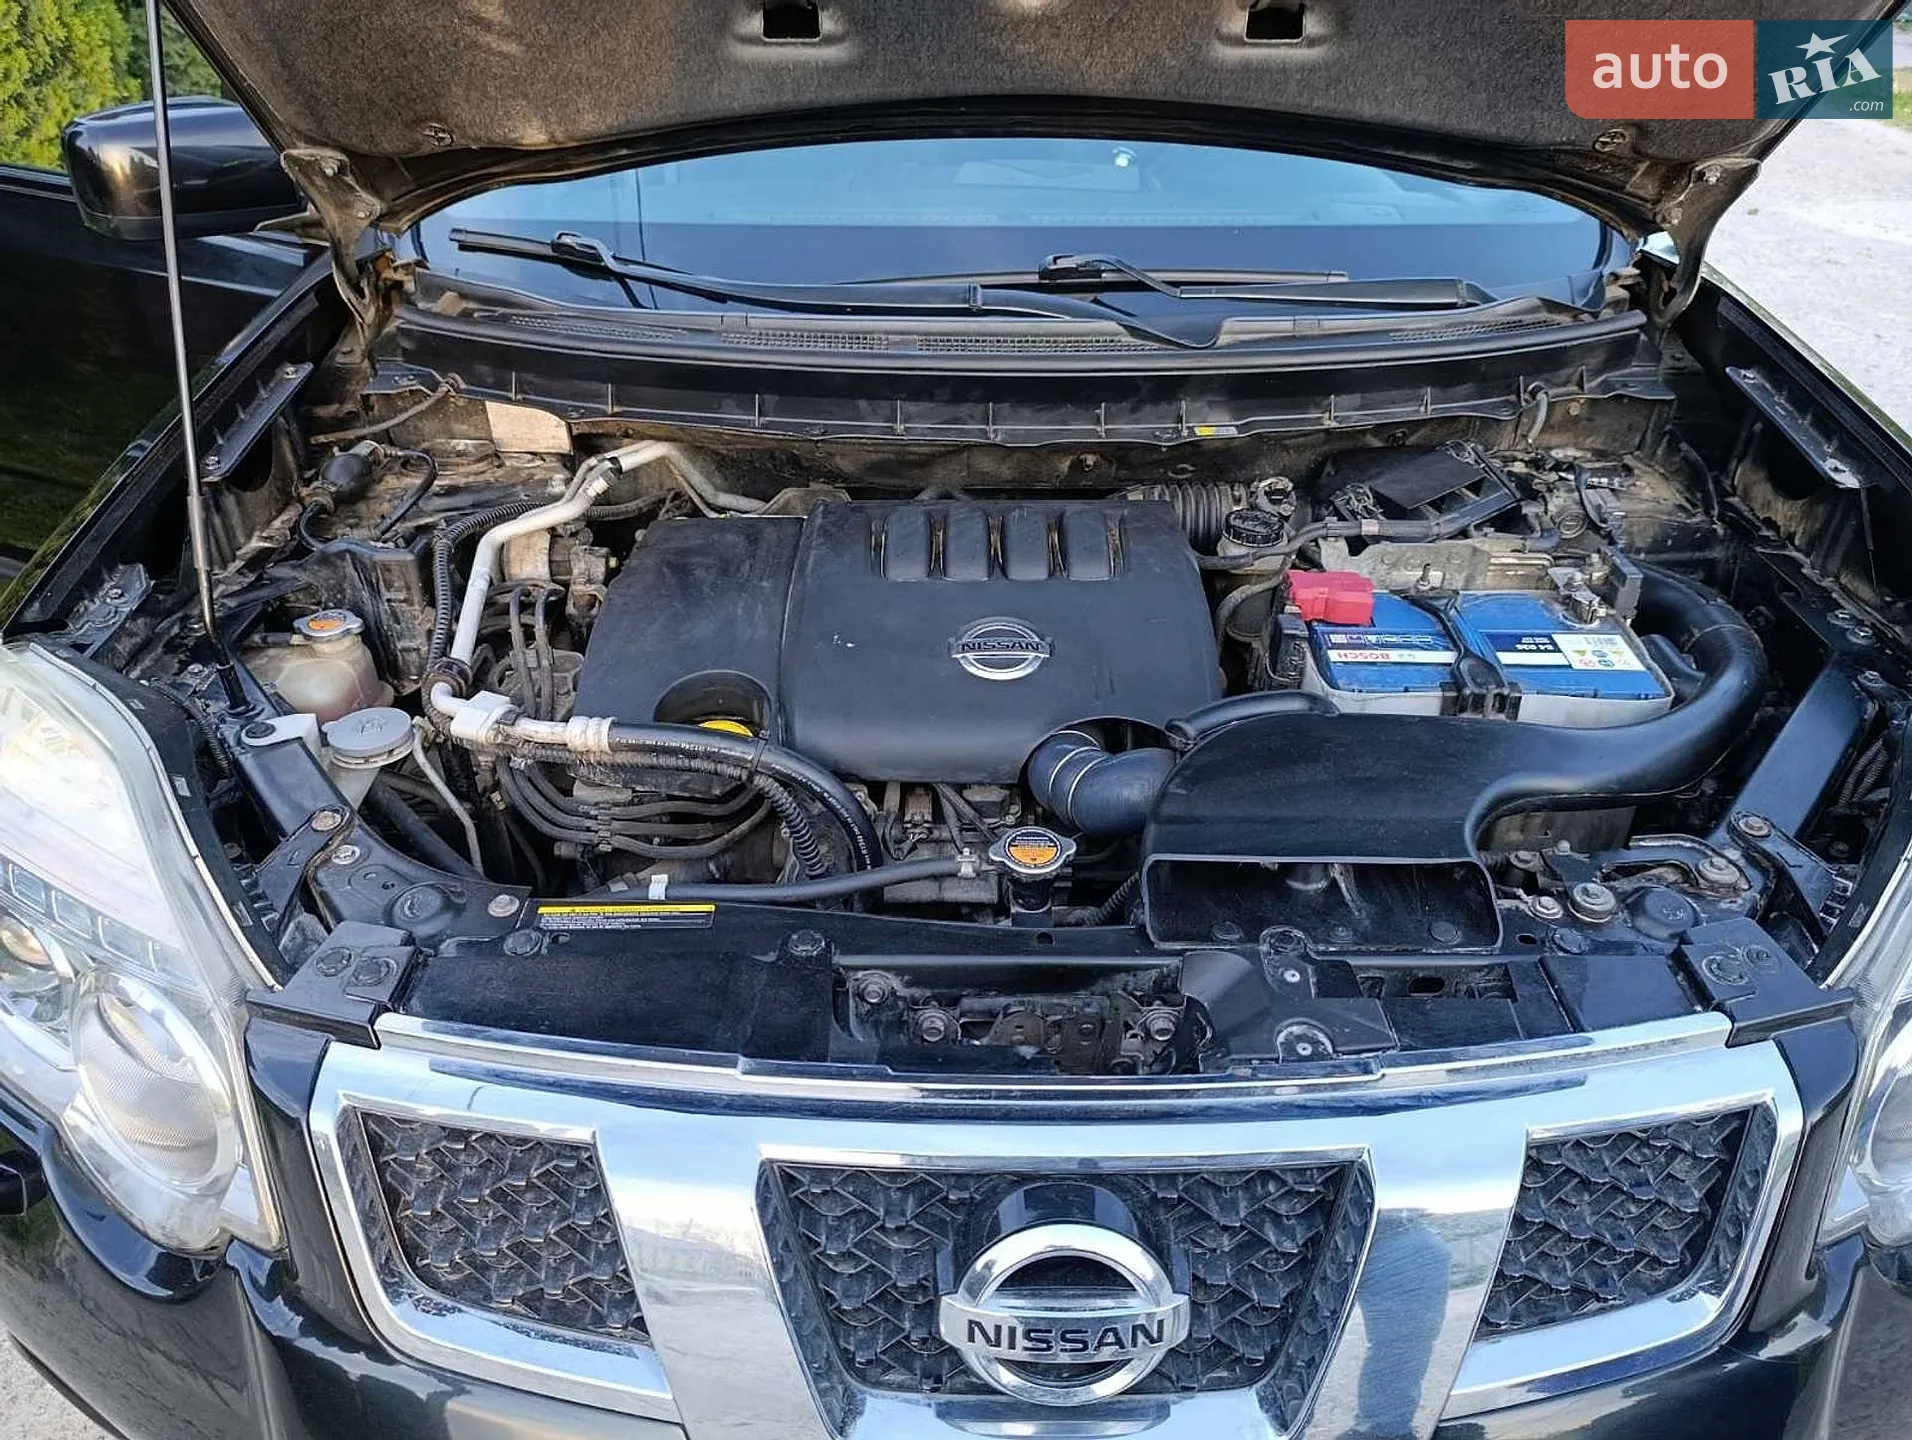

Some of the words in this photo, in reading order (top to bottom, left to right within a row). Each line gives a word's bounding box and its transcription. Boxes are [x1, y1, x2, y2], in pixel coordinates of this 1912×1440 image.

[961, 641, 1040, 651] NISSAN
[1336, 652, 1390, 660] BOSCH
[967, 1319, 1165, 1353] NISSAN
